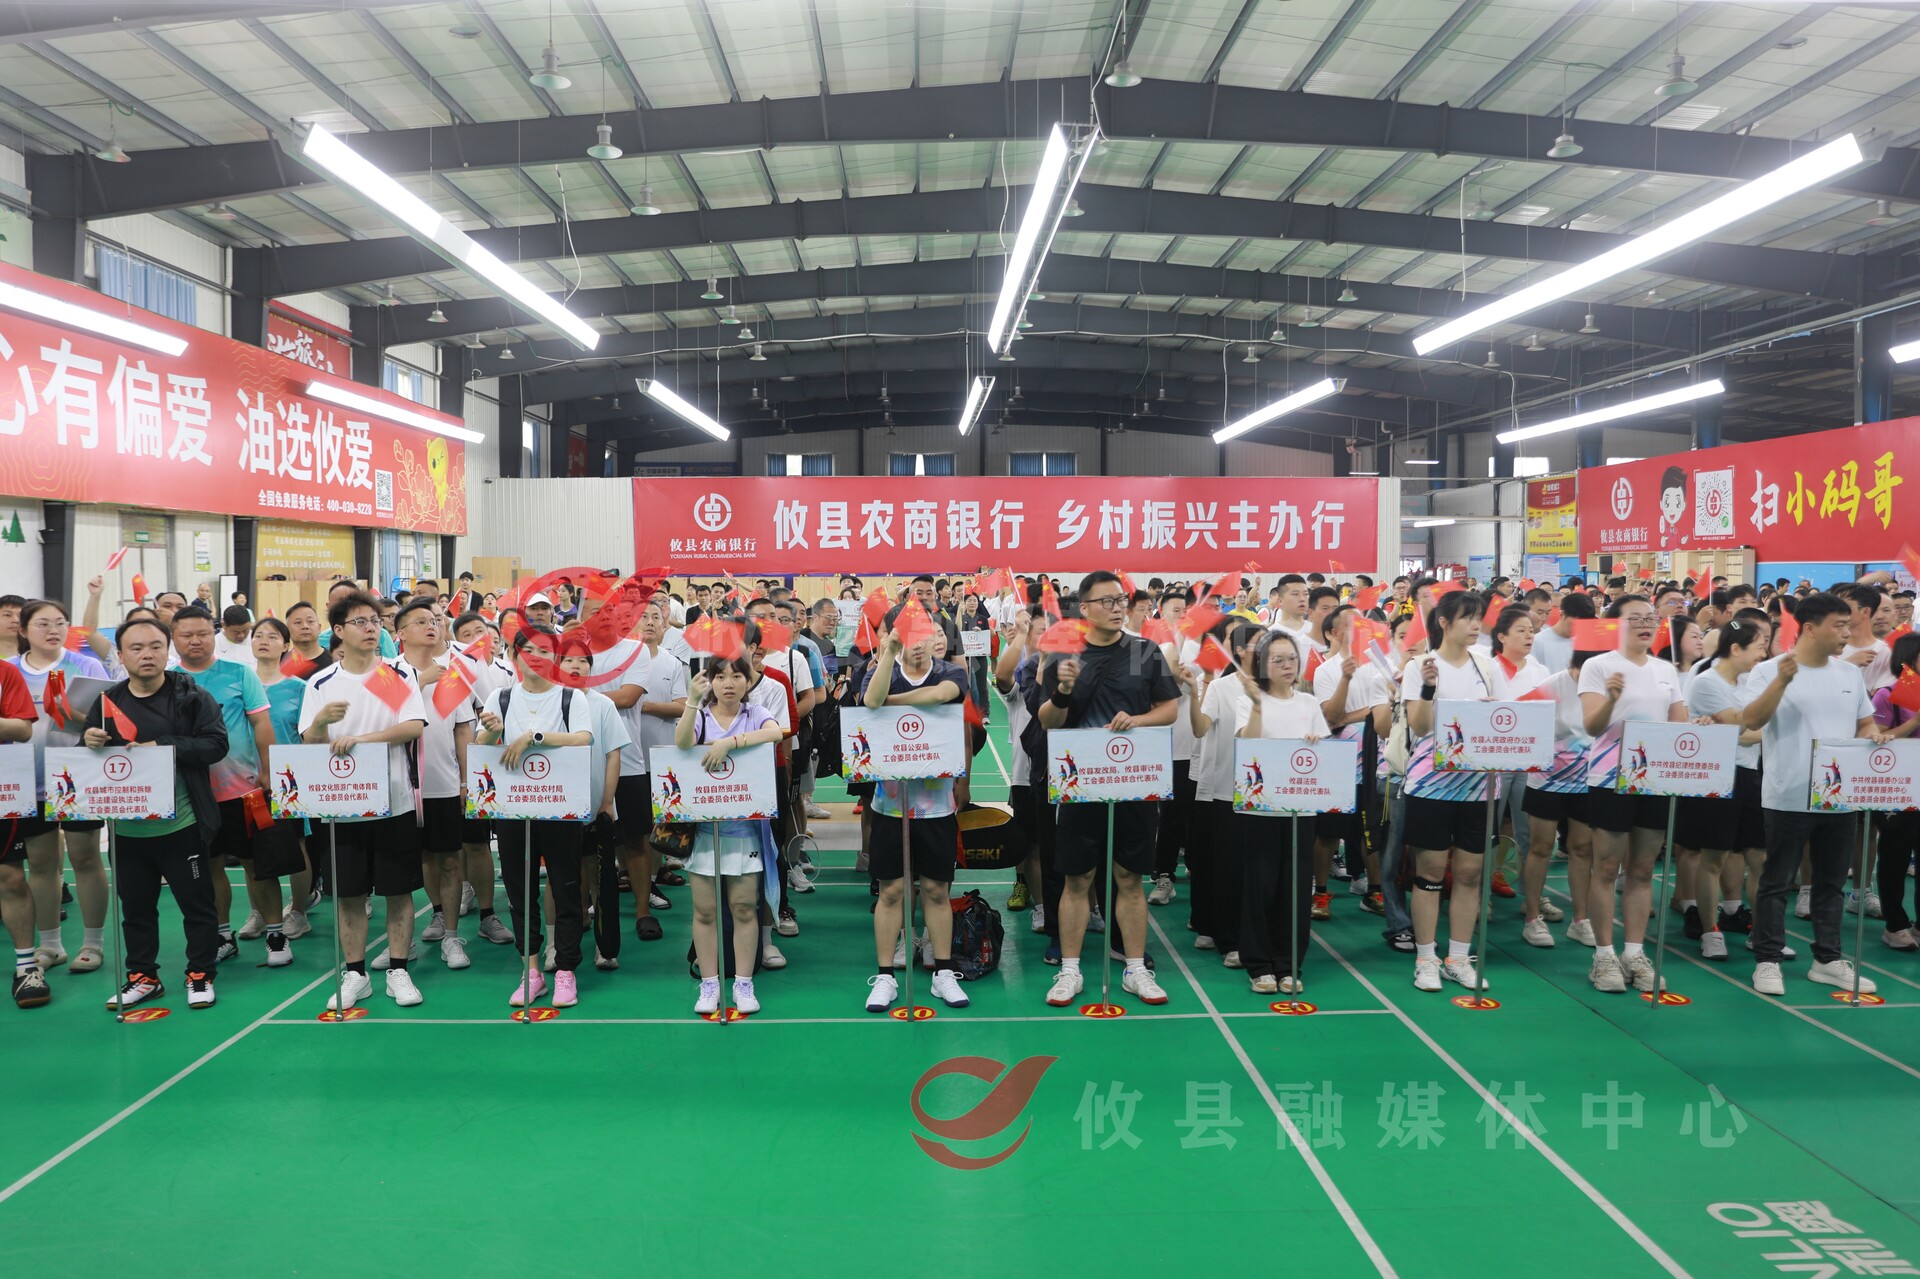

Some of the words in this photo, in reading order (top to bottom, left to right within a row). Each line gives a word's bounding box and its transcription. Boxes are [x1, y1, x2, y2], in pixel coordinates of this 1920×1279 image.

[235, 388, 374, 490] 油选攸爱
[1750, 451, 1904, 534] 扫小码哥
[773, 499, 1024, 549] 攸县农商银行
[1057, 499, 1345, 550] 乡村振兴主办行
[1600, 527, 1648, 544] 攸县农商银行
[670, 538, 756, 552] 攸县农商银行
[1495, 714, 1512, 725] 03
[901, 721, 919, 733] 09
[1470, 735, 1536, 744] 攸县人民政府办公室
[893, 743, 930, 752] 攸县公安局
[1111, 744, 1129, 755] 07
[1473, 745, 1532, 754] 工会委员会代表队
[1679, 740, 1696, 751] 01
[882, 752, 941, 763] 工会委员会代表队
[1295, 755, 1313, 767] 05
[1873, 755, 1892, 766] 02
[109, 762, 127, 774] 17
[334, 759, 351, 771] 15
[528, 761, 545, 773] 13
[1649, 760, 1721, 771] 中共攸县纪律检查委员会
[1082, 774, 1160, 785] 工会委员会联合代表队
[1657, 770, 1710, 780] 工会委员会代表队
[1850, 776, 1912, 784] 中共攸县县委办公室
[1288, 777, 1318, 786] 攸县法院
[0, 783, 20, 792] 理局
[85, 785, 152, 795] 攸县城市控制和拆除
[308, 782, 378, 792] 攸县文化旅游广电体育局
[510, 784, 564, 793] 攸县农业农村局
[695, 783, 749, 794] 攸县自然资源局
[1274, 786, 1331, 796] 工会委员会代表队
[1853, 785, 1907, 794] 机关事务服务中心
[88, 796, 149, 804] 违法建设执法中队
[318, 793, 369, 802] 工会委员会代表队
[506, 794, 567, 803] 工会委员会代表队
[692, 794, 753, 804] 工会委员会代表队
[1845, 795, 1913, 804] 工会委员会联合代表队
[89, 805, 149, 815] 工会委员会代表队
